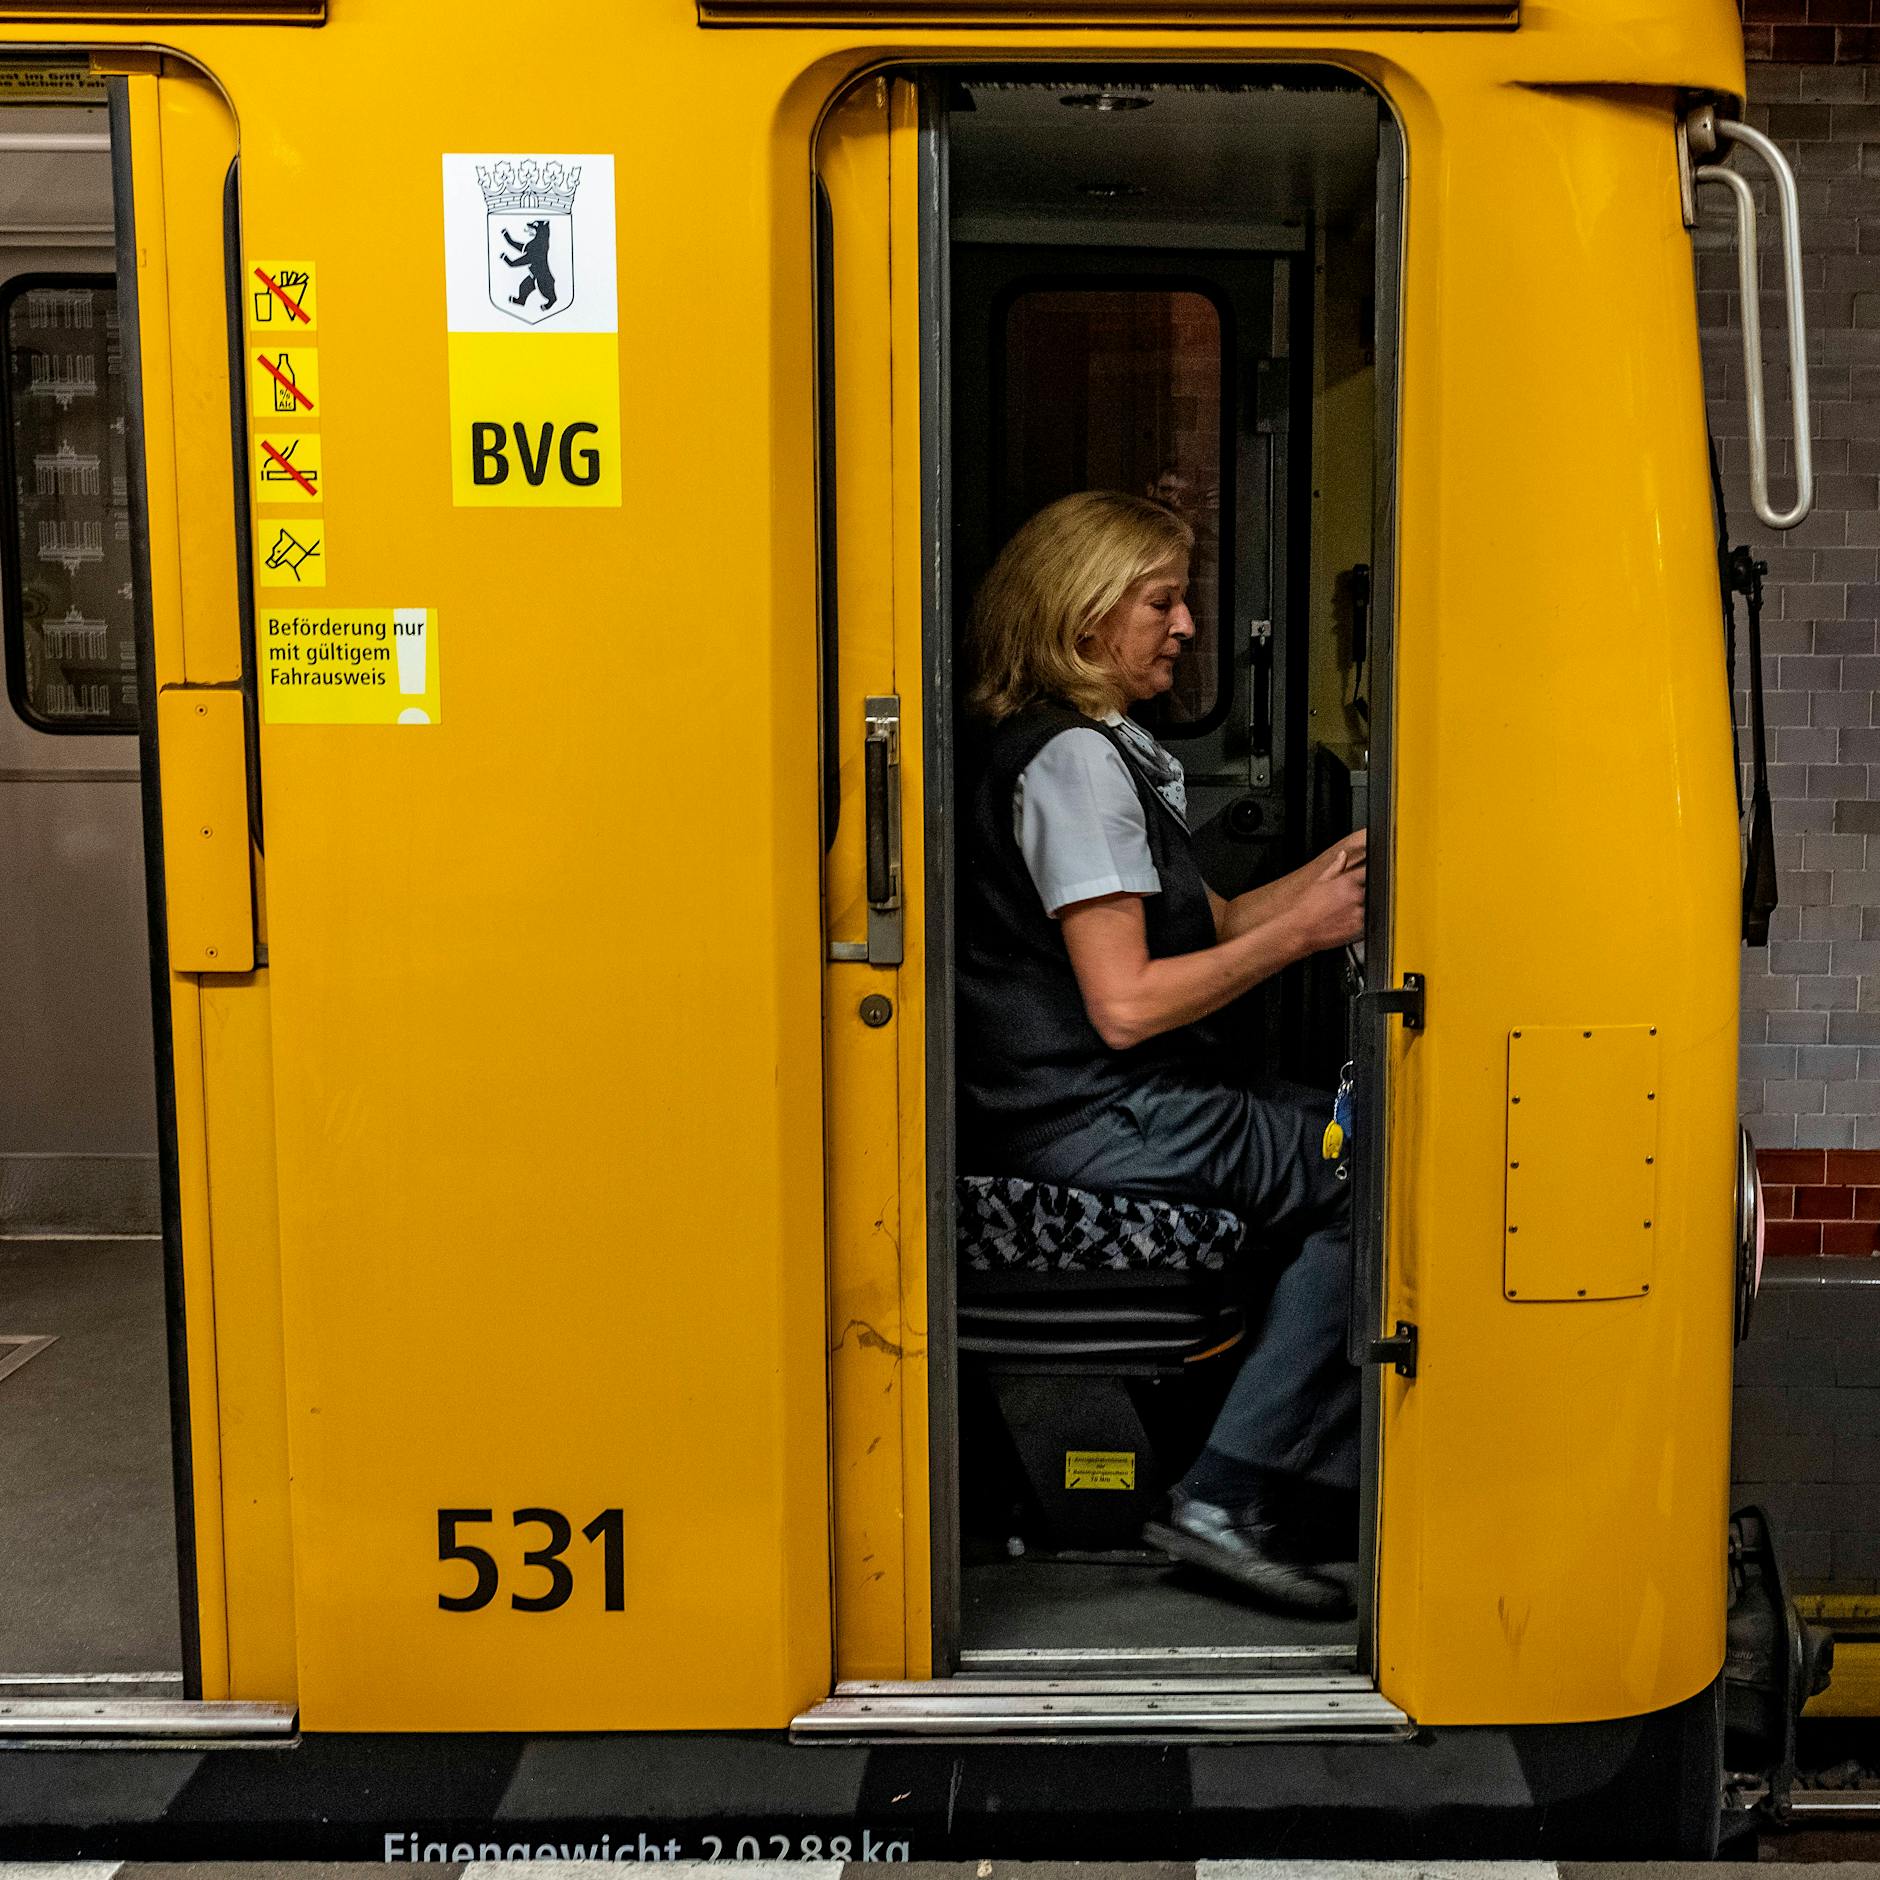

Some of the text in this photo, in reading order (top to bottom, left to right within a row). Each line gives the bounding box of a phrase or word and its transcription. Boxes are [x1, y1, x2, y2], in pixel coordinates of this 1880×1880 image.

[471, 421, 601, 487] BVG
[268, 618, 424, 640] Beförderung nur
[269, 643, 300, 660] mit
[306, 643, 390, 665] gültigem
[270, 668, 386, 686] Fahrausweis
[437, 1507, 625, 1613] 531
